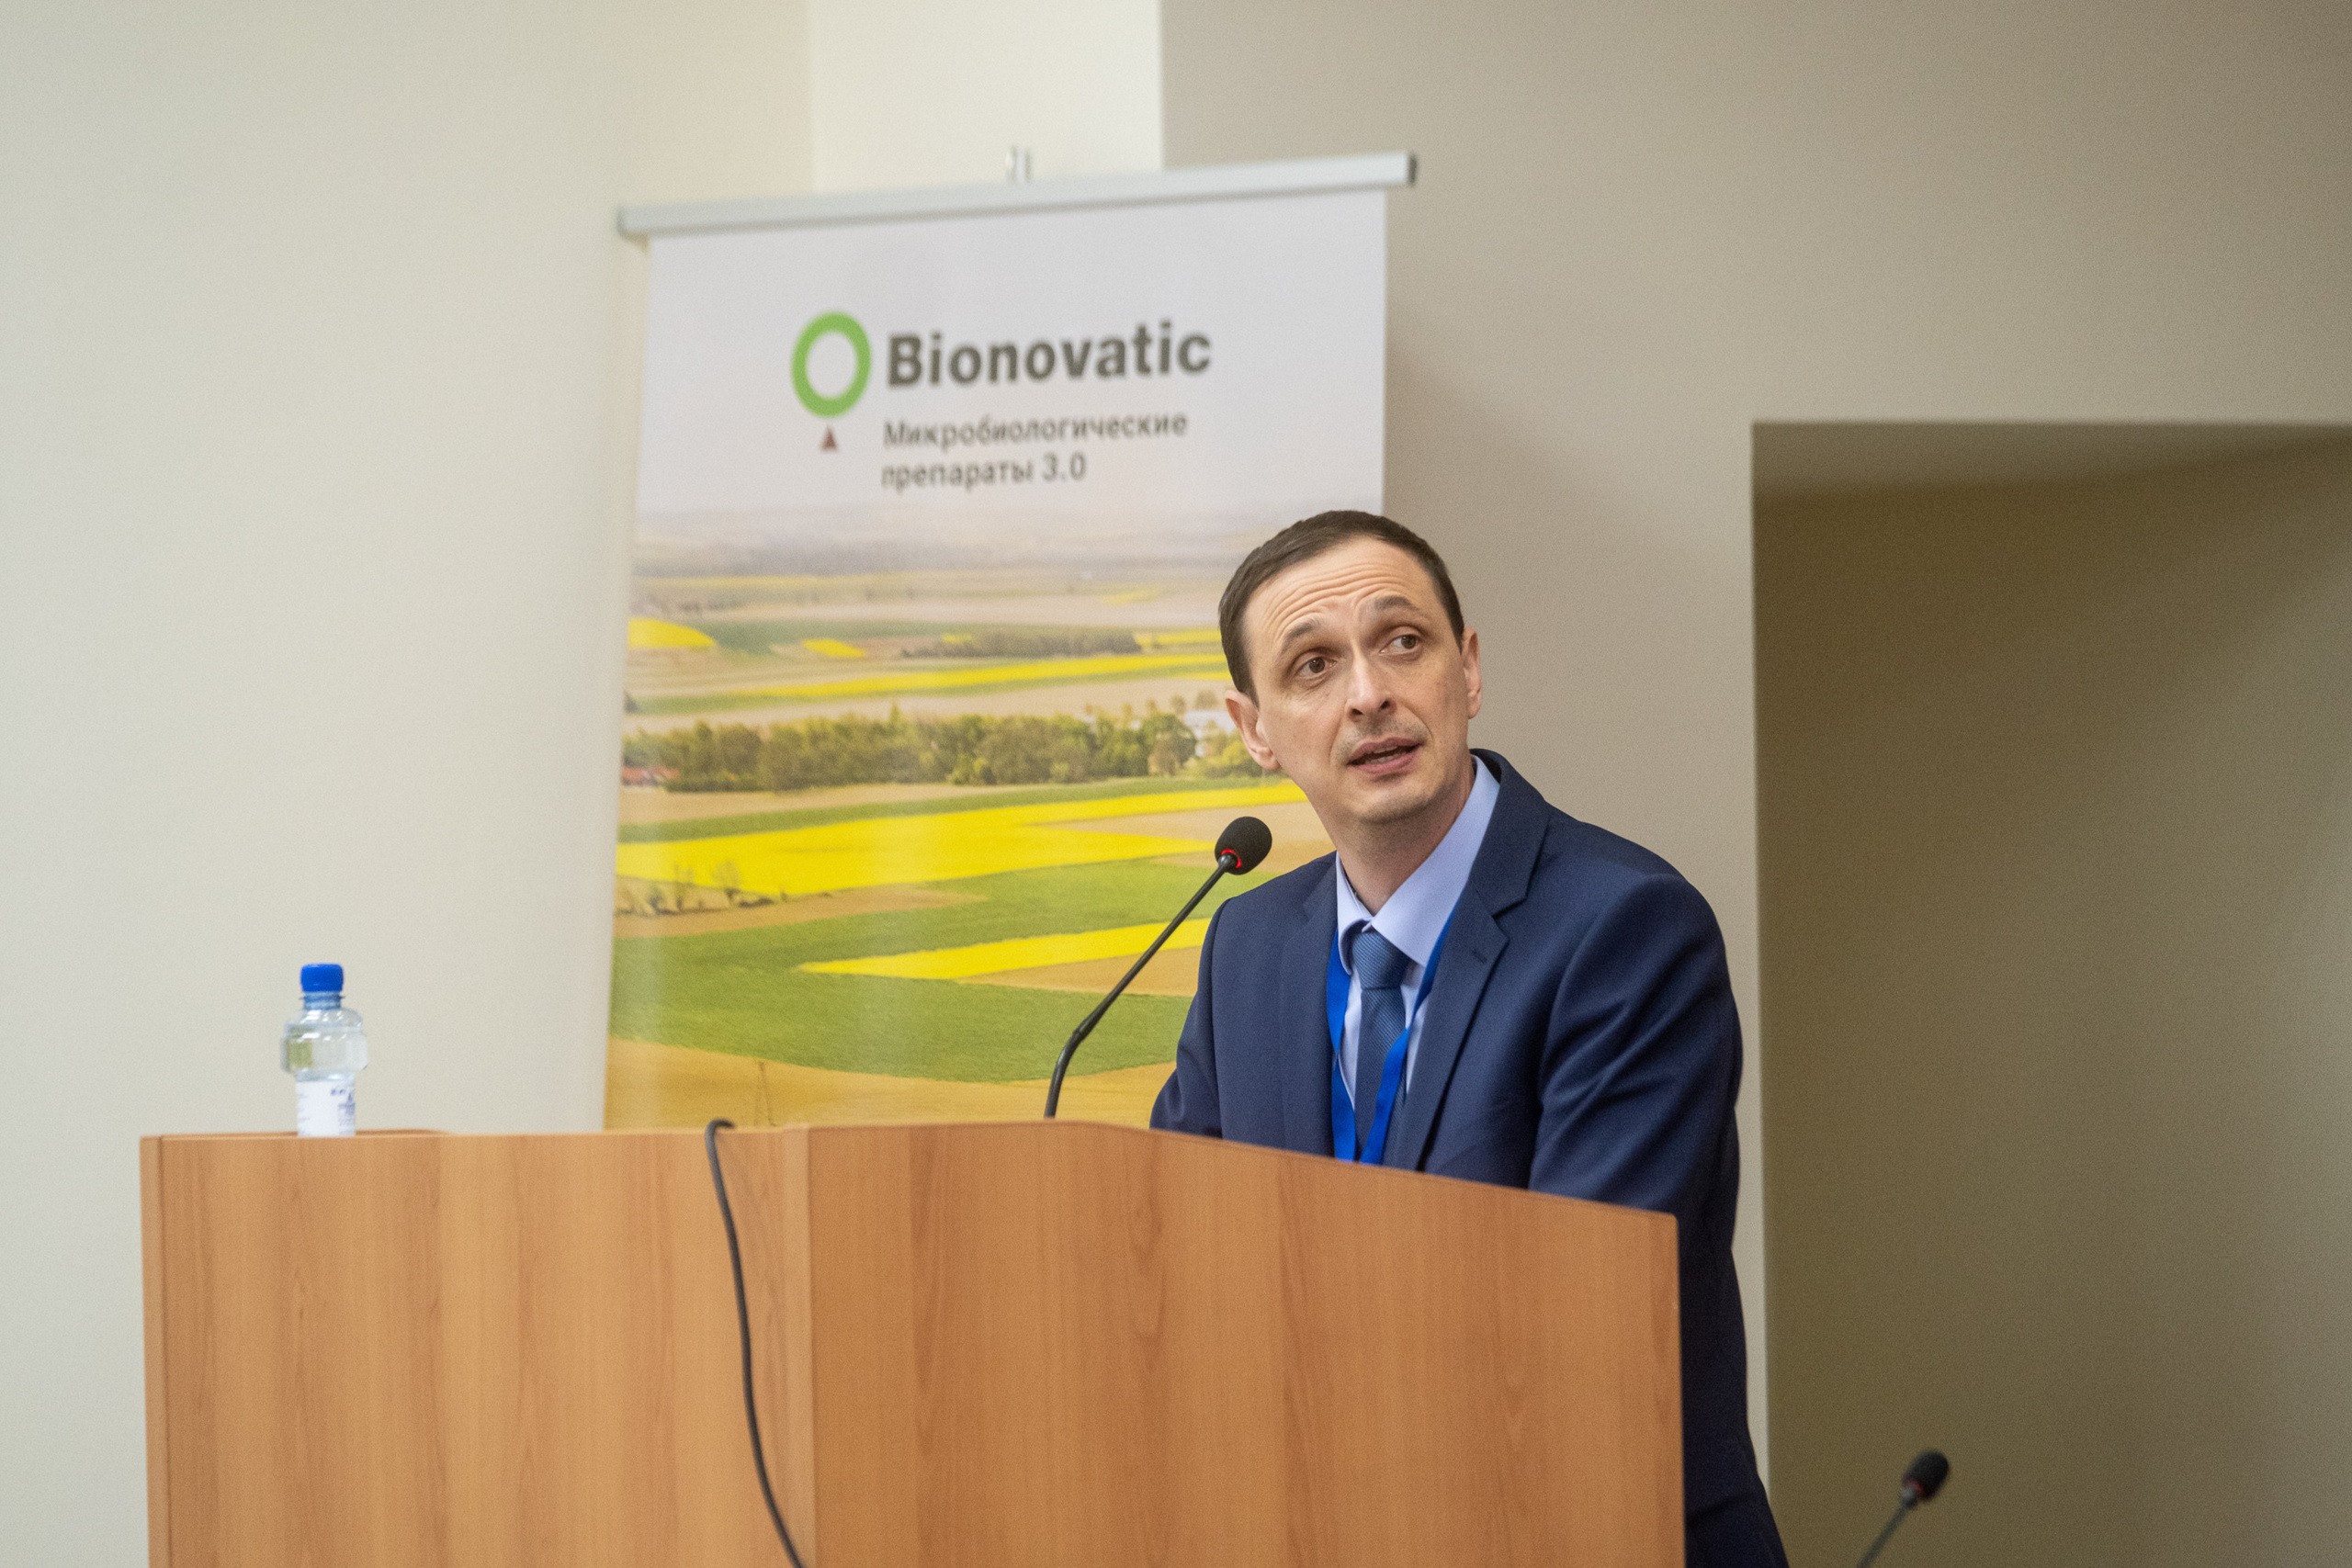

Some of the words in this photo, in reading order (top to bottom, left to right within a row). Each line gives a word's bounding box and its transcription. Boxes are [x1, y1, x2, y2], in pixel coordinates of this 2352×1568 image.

[888, 319, 1212, 387] Bionovatic
[883, 412, 1188, 452] Микробиологические
[881, 460, 1033, 493] препараты
[1043, 453, 1087, 481] 3.0
